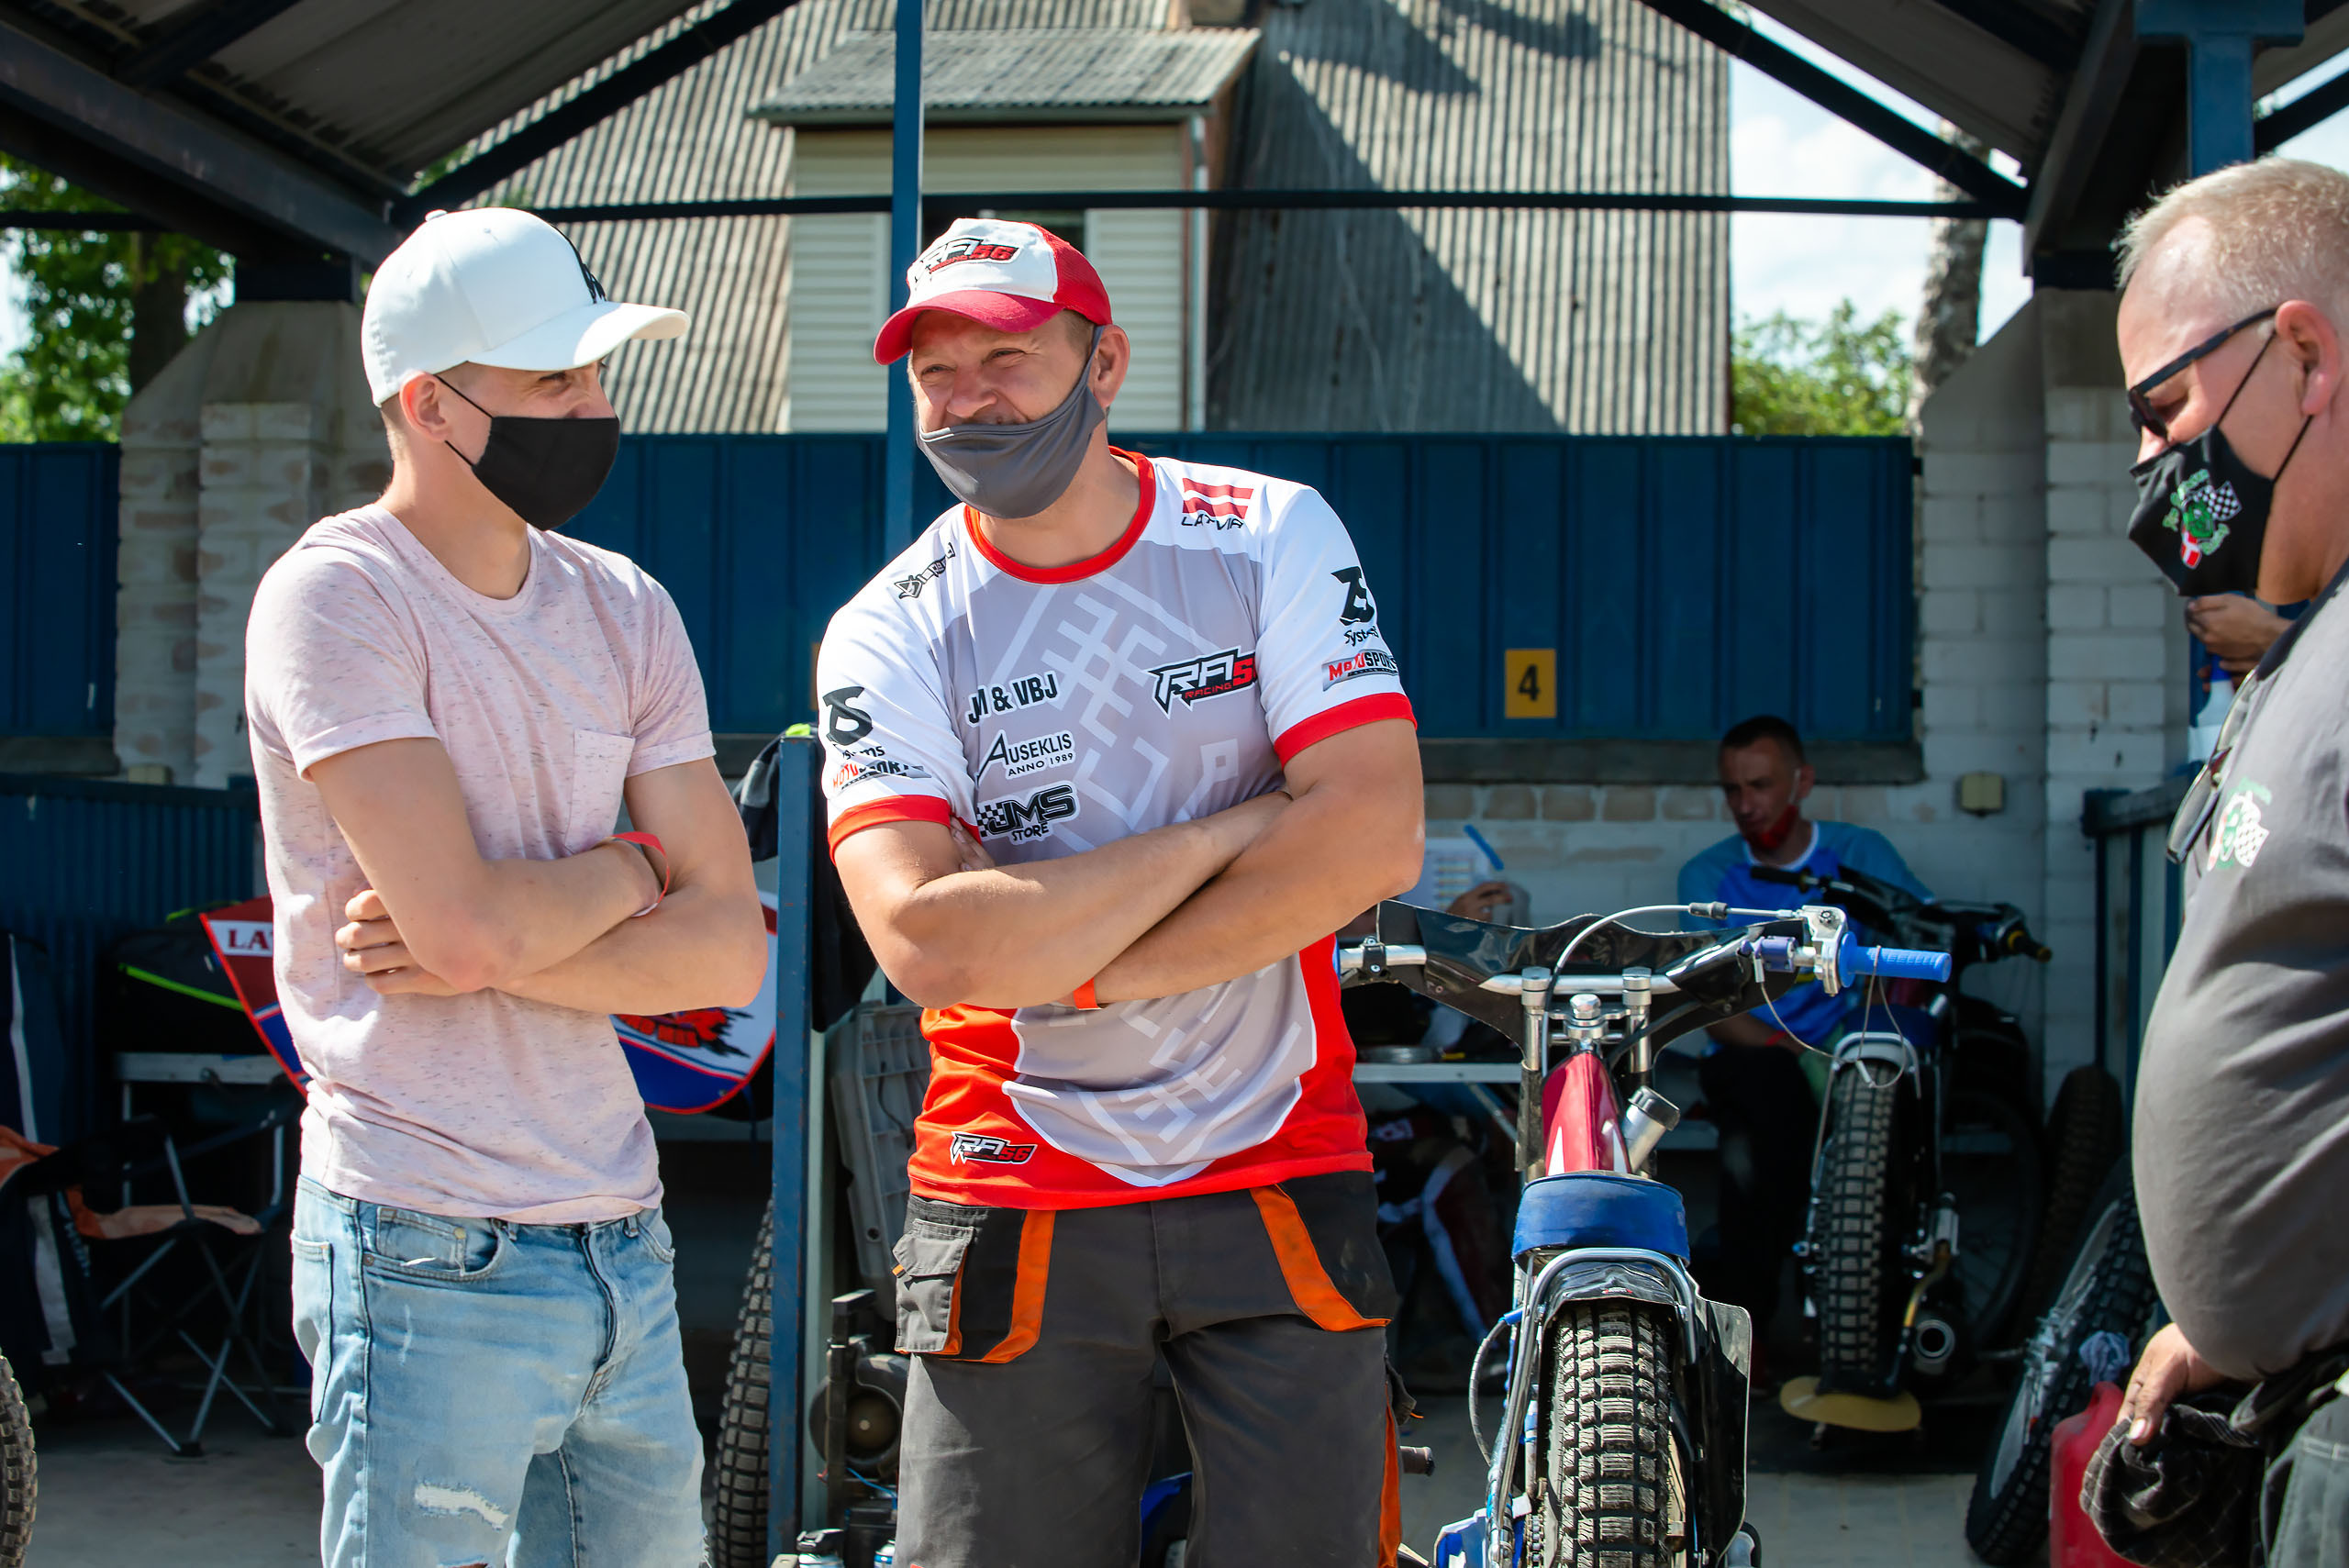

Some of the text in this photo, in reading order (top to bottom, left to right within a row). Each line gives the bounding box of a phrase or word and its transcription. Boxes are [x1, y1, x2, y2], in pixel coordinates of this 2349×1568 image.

[991, 686, 1014, 712] &
[1012, 673, 1058, 706] VBJ
[1184, 682, 1232, 699] RACING
[1518, 663, 1541, 701] 4
[1008, 752, 1074, 777] ANNO 1989
[987, 784, 1076, 836] JMS
[1011, 822, 1050, 841] STORE
[228, 929, 273, 951] LA
